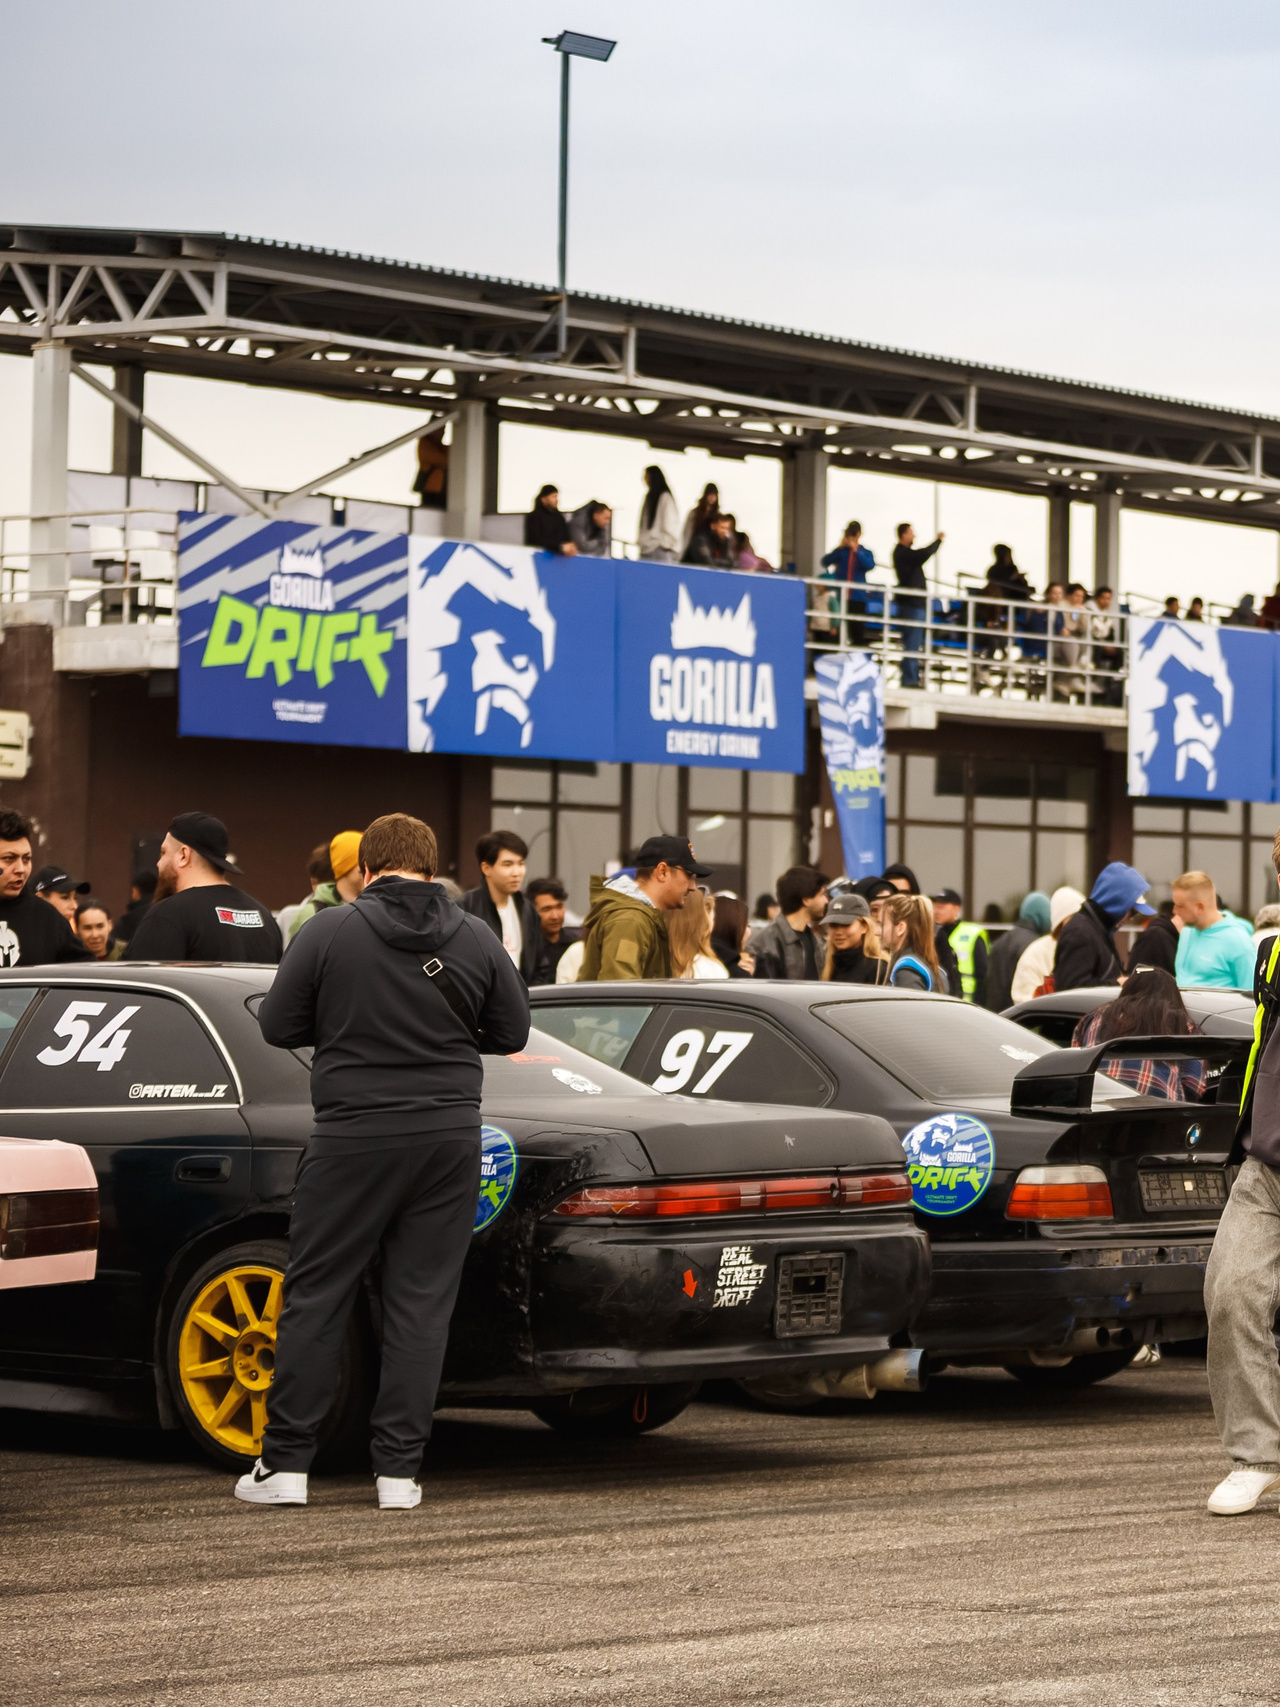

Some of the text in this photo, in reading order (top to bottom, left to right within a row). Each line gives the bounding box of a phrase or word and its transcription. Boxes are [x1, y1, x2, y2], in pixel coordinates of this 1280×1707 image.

[270, 574, 335, 611] GORILLA
[201, 594, 394, 698] DRIFT
[650, 653, 777, 729] GORILLA
[666, 729, 760, 759] ENERGY DRINK
[232, 912, 262, 925] GARAGE
[36, 1001, 141, 1071] 54
[652, 1029, 754, 1094] 97
[947, 1152, 976, 1163] GORILLA
[907, 1164, 984, 1193] DRIFT
[720, 1246, 754, 1266] REAL
[717, 1264, 767, 1287] STREET
[712, 1286, 759, 1308] DRIFT
